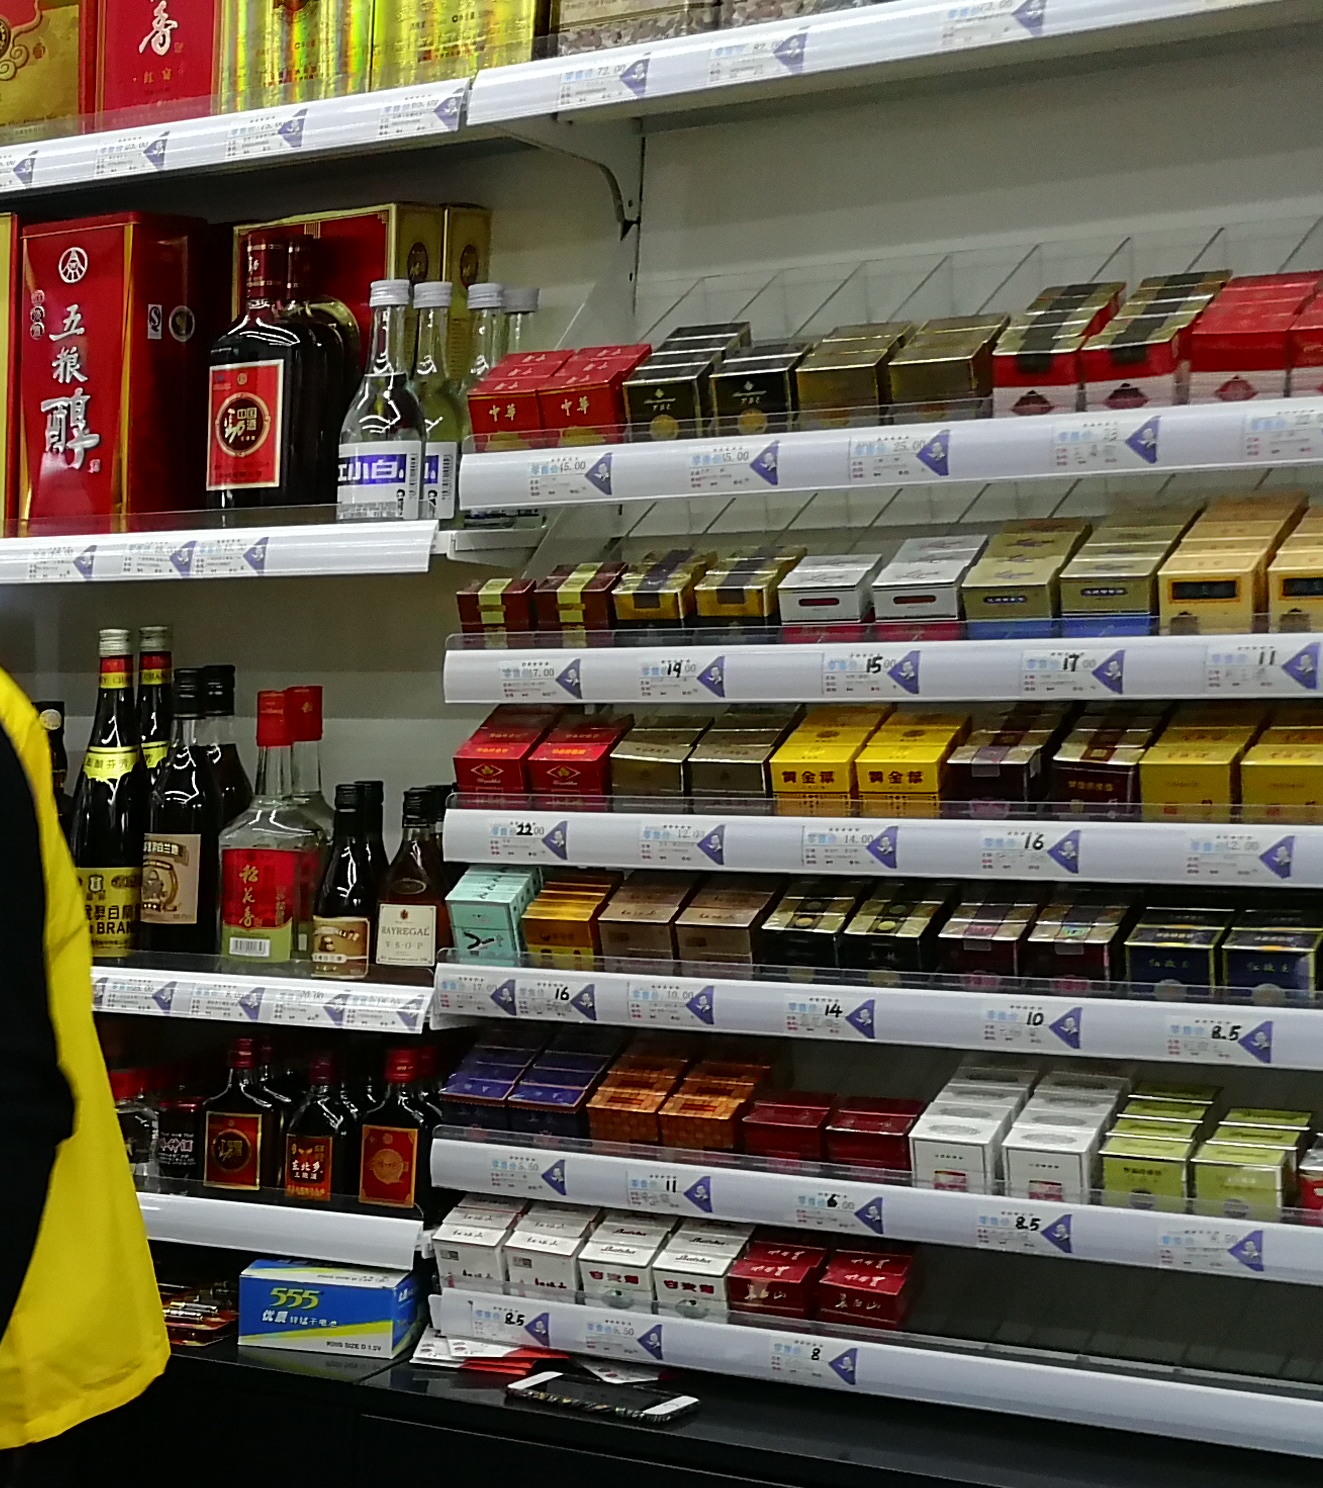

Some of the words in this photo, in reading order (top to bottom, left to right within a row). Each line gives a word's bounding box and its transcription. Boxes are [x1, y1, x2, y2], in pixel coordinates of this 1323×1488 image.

[1024, 833, 1045, 851] 16
[554, 987, 570, 1001] 16
[825, 1004, 843, 1018] 14
[269, 1287, 320, 1310] 555
